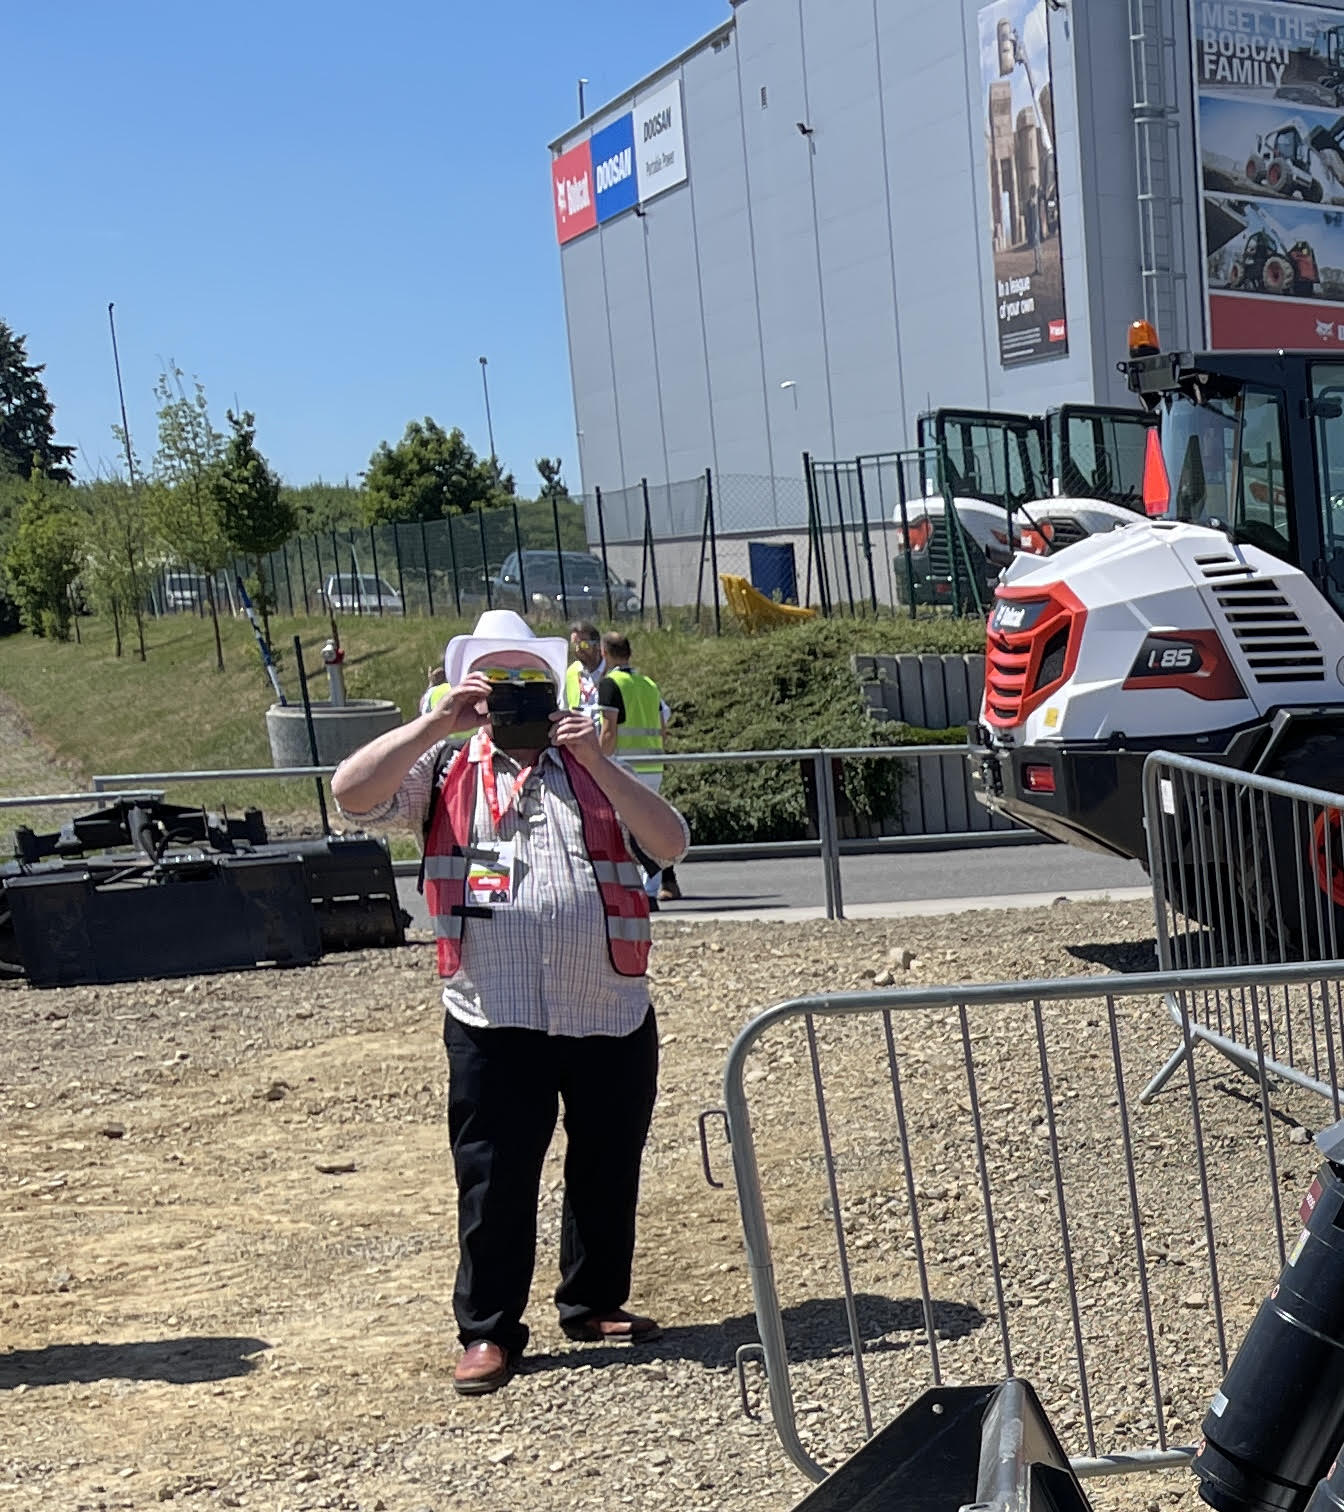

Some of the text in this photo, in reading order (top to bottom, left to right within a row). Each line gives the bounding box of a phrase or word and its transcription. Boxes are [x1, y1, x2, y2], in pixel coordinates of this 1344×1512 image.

[1202, 3, 1316, 42] MEET THE
[1203, 28, 1291, 65] BOBCAT
[1204, 54, 1286, 88] FAMILY
[643, 106, 672, 143] DOOSAN
[596, 146, 632, 194] DOOSAN
[566, 169, 591, 216] Bobcat
[1009, 275, 1031, 297] league
[999, 297, 1035, 321] of your own
[1148, 648, 1193, 668] L85
